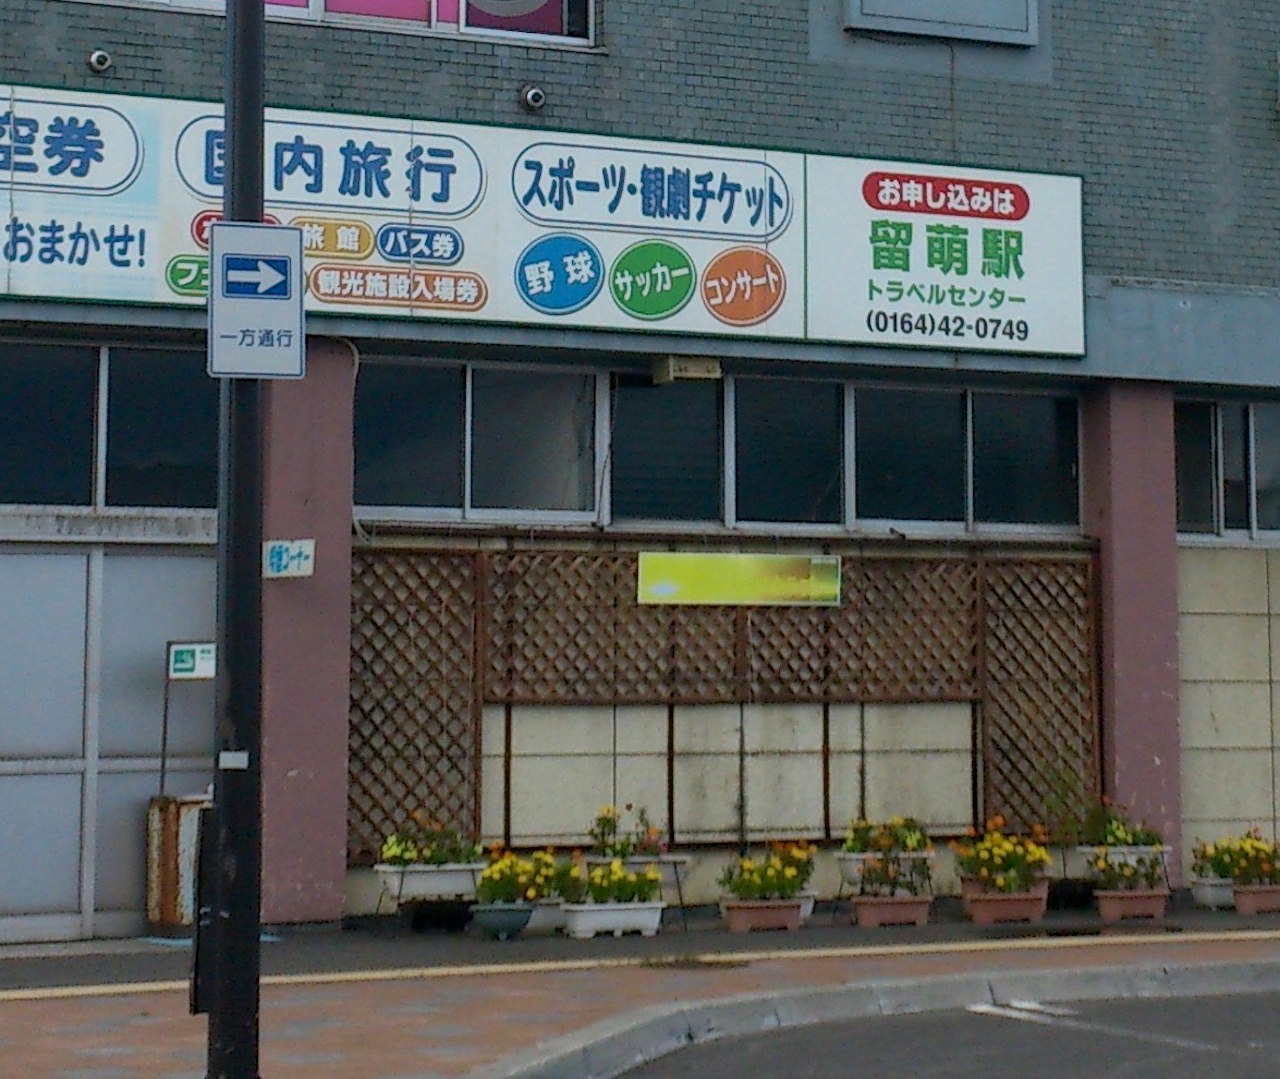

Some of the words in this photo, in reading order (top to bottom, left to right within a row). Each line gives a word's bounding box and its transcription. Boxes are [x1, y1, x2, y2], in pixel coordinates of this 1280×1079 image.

[521, 156, 785, 228] スポーツ・観劇チケット
[877, 177, 1016, 216] お申し込みは
[384, 229, 459, 261] バス券
[869, 219, 1025, 280] 留萌駅
[317, 270, 480, 305] 観光施設入場券
[523, 250, 596, 295] 野球
[615, 261, 691, 303] サッカー
[705, 261, 781, 307] コンサート
[867, 279, 1028, 310] トラベルセンター
[220, 328, 294, 348] 一方通行
[865, 310, 1030, 342] (0164)42-0749
